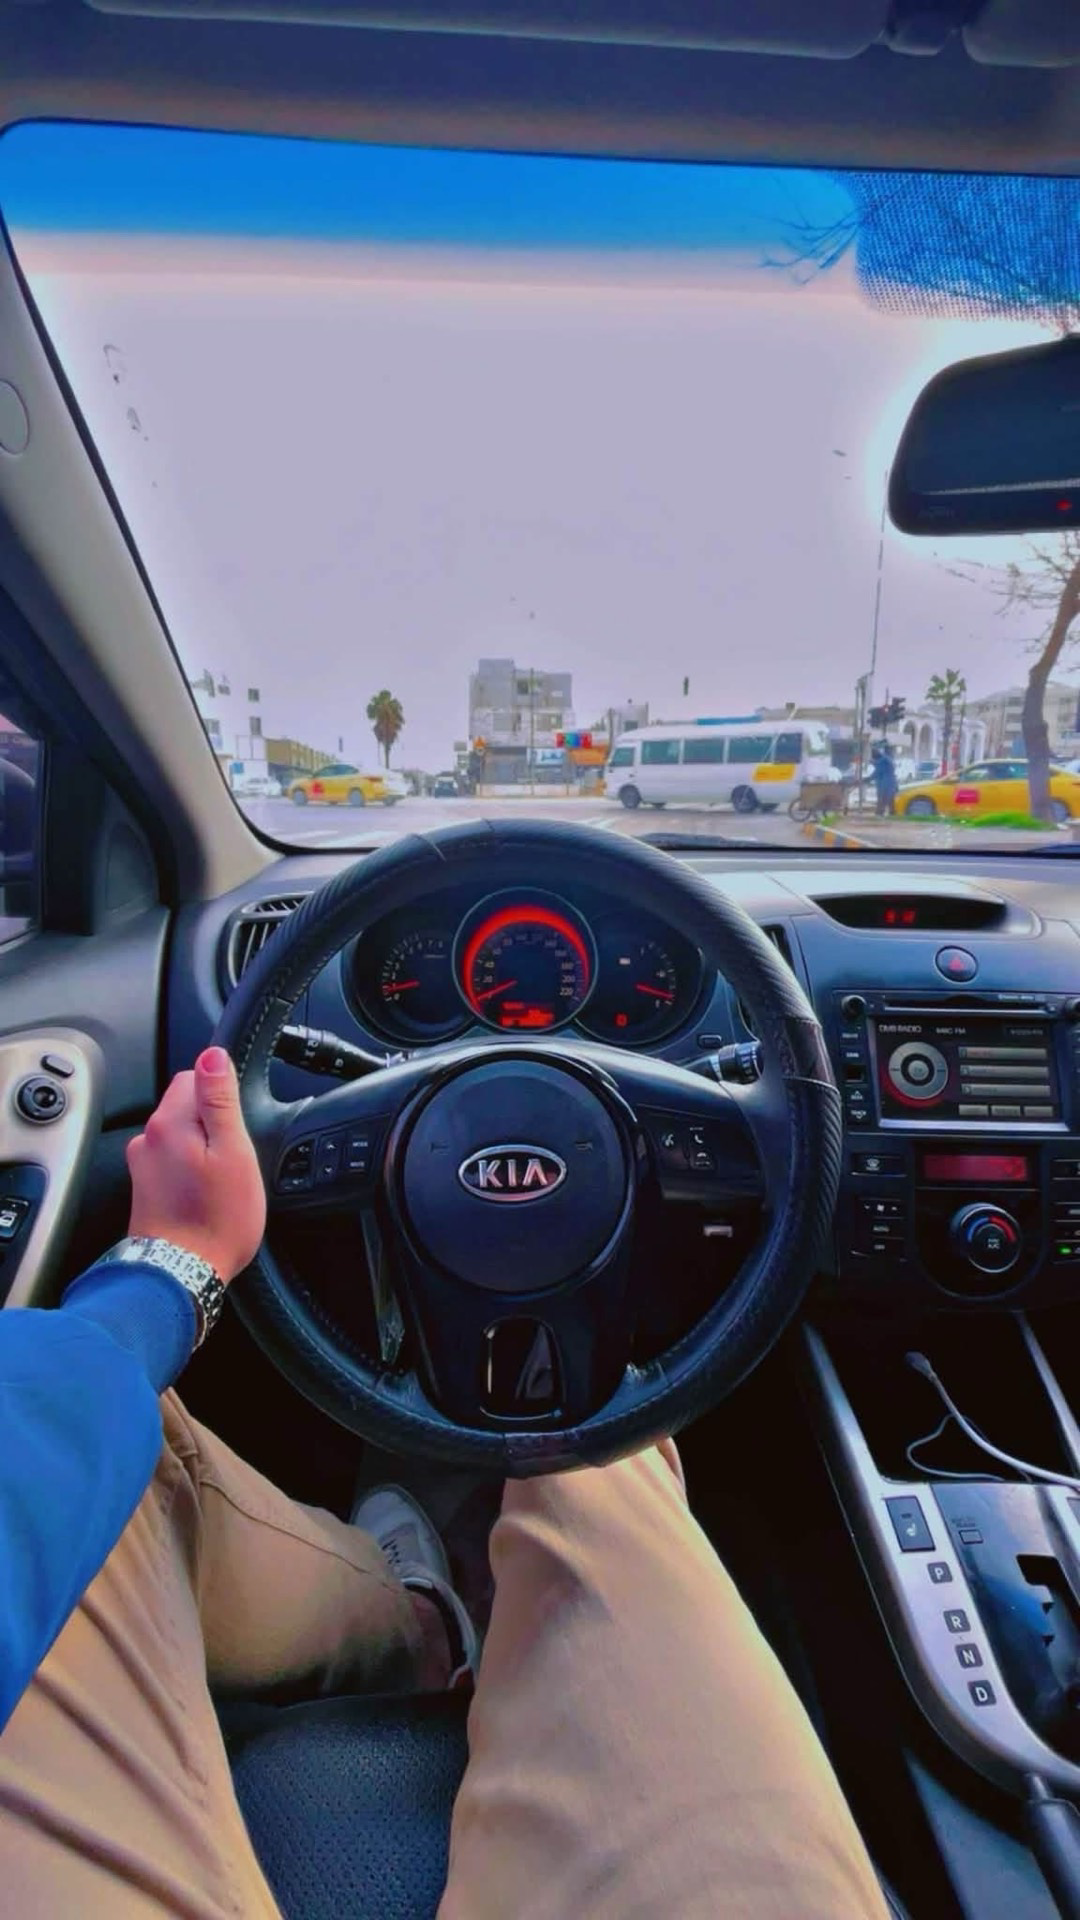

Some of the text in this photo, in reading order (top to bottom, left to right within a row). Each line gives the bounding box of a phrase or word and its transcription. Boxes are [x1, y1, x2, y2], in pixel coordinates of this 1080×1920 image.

[898, 1025, 922, 1033] RADIO
[478, 1158, 548, 1188] KIA
[934, 1567, 944, 1580] P
[951, 1615, 963, 1630] R
[962, 1650, 976, 1665] N
[975, 1686, 989, 1702] D
